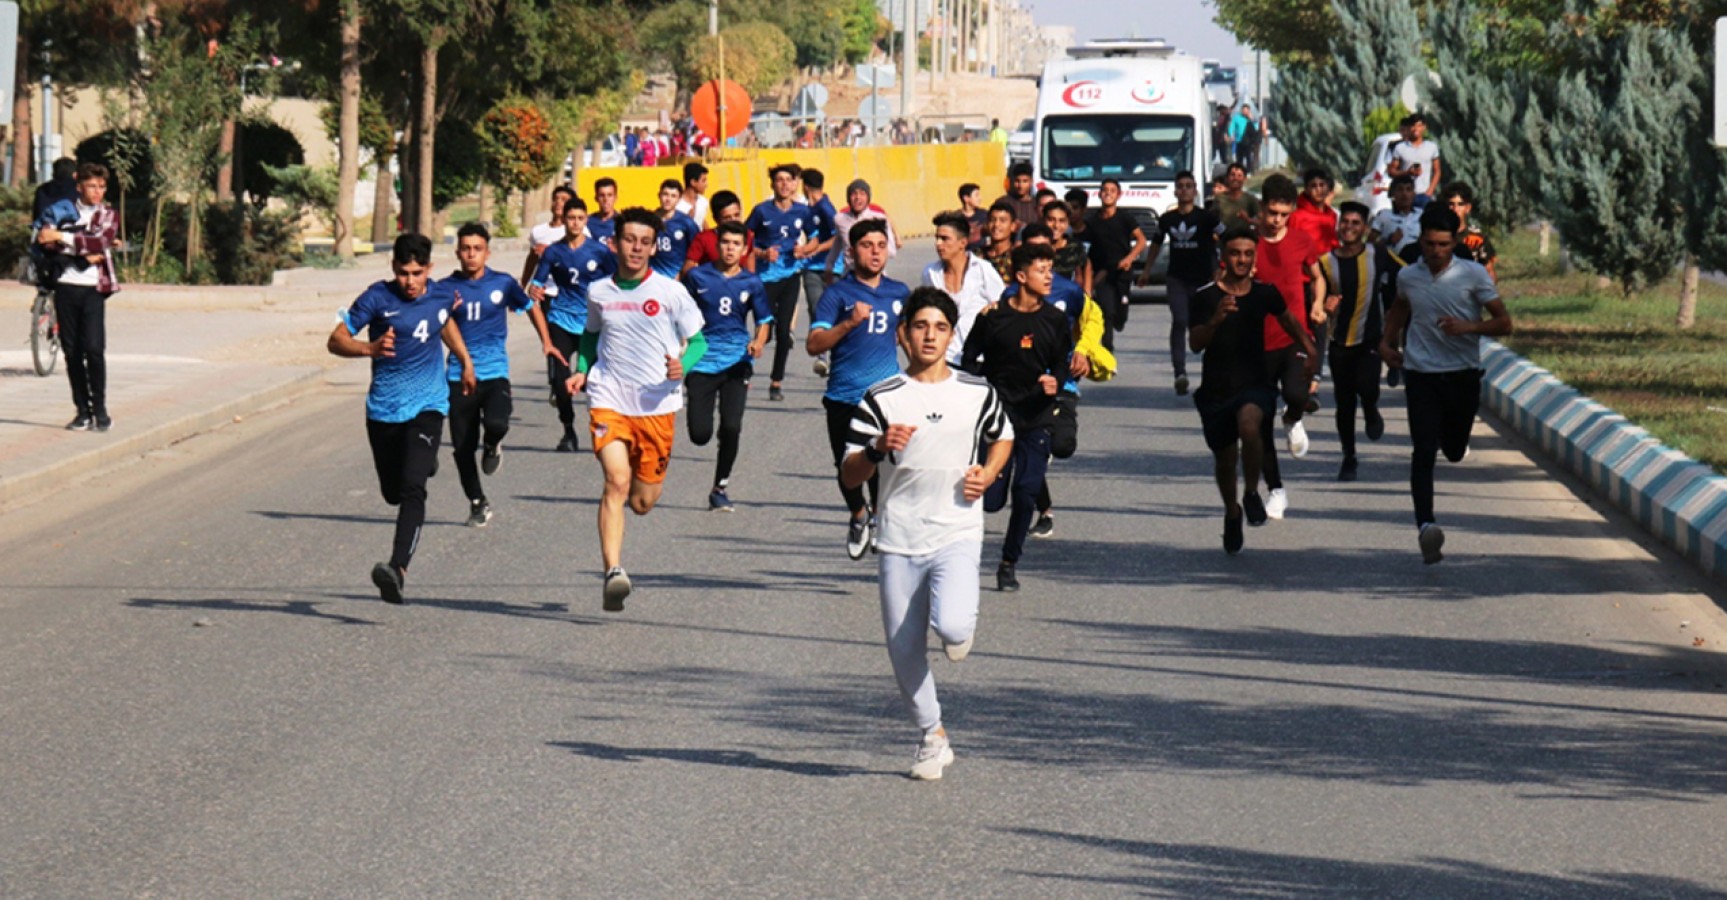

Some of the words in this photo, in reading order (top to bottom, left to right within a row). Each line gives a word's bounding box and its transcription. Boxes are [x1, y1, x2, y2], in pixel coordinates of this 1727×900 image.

[1079, 88, 1101, 99] 112
[780, 225, 789, 237] 5
[656, 236, 671, 252] 18
[568, 267, 580, 284] 2
[467, 301, 480, 321] 11
[719, 296, 732, 315] 8
[412, 319, 430, 343] 4
[868, 311, 888, 333] 13
